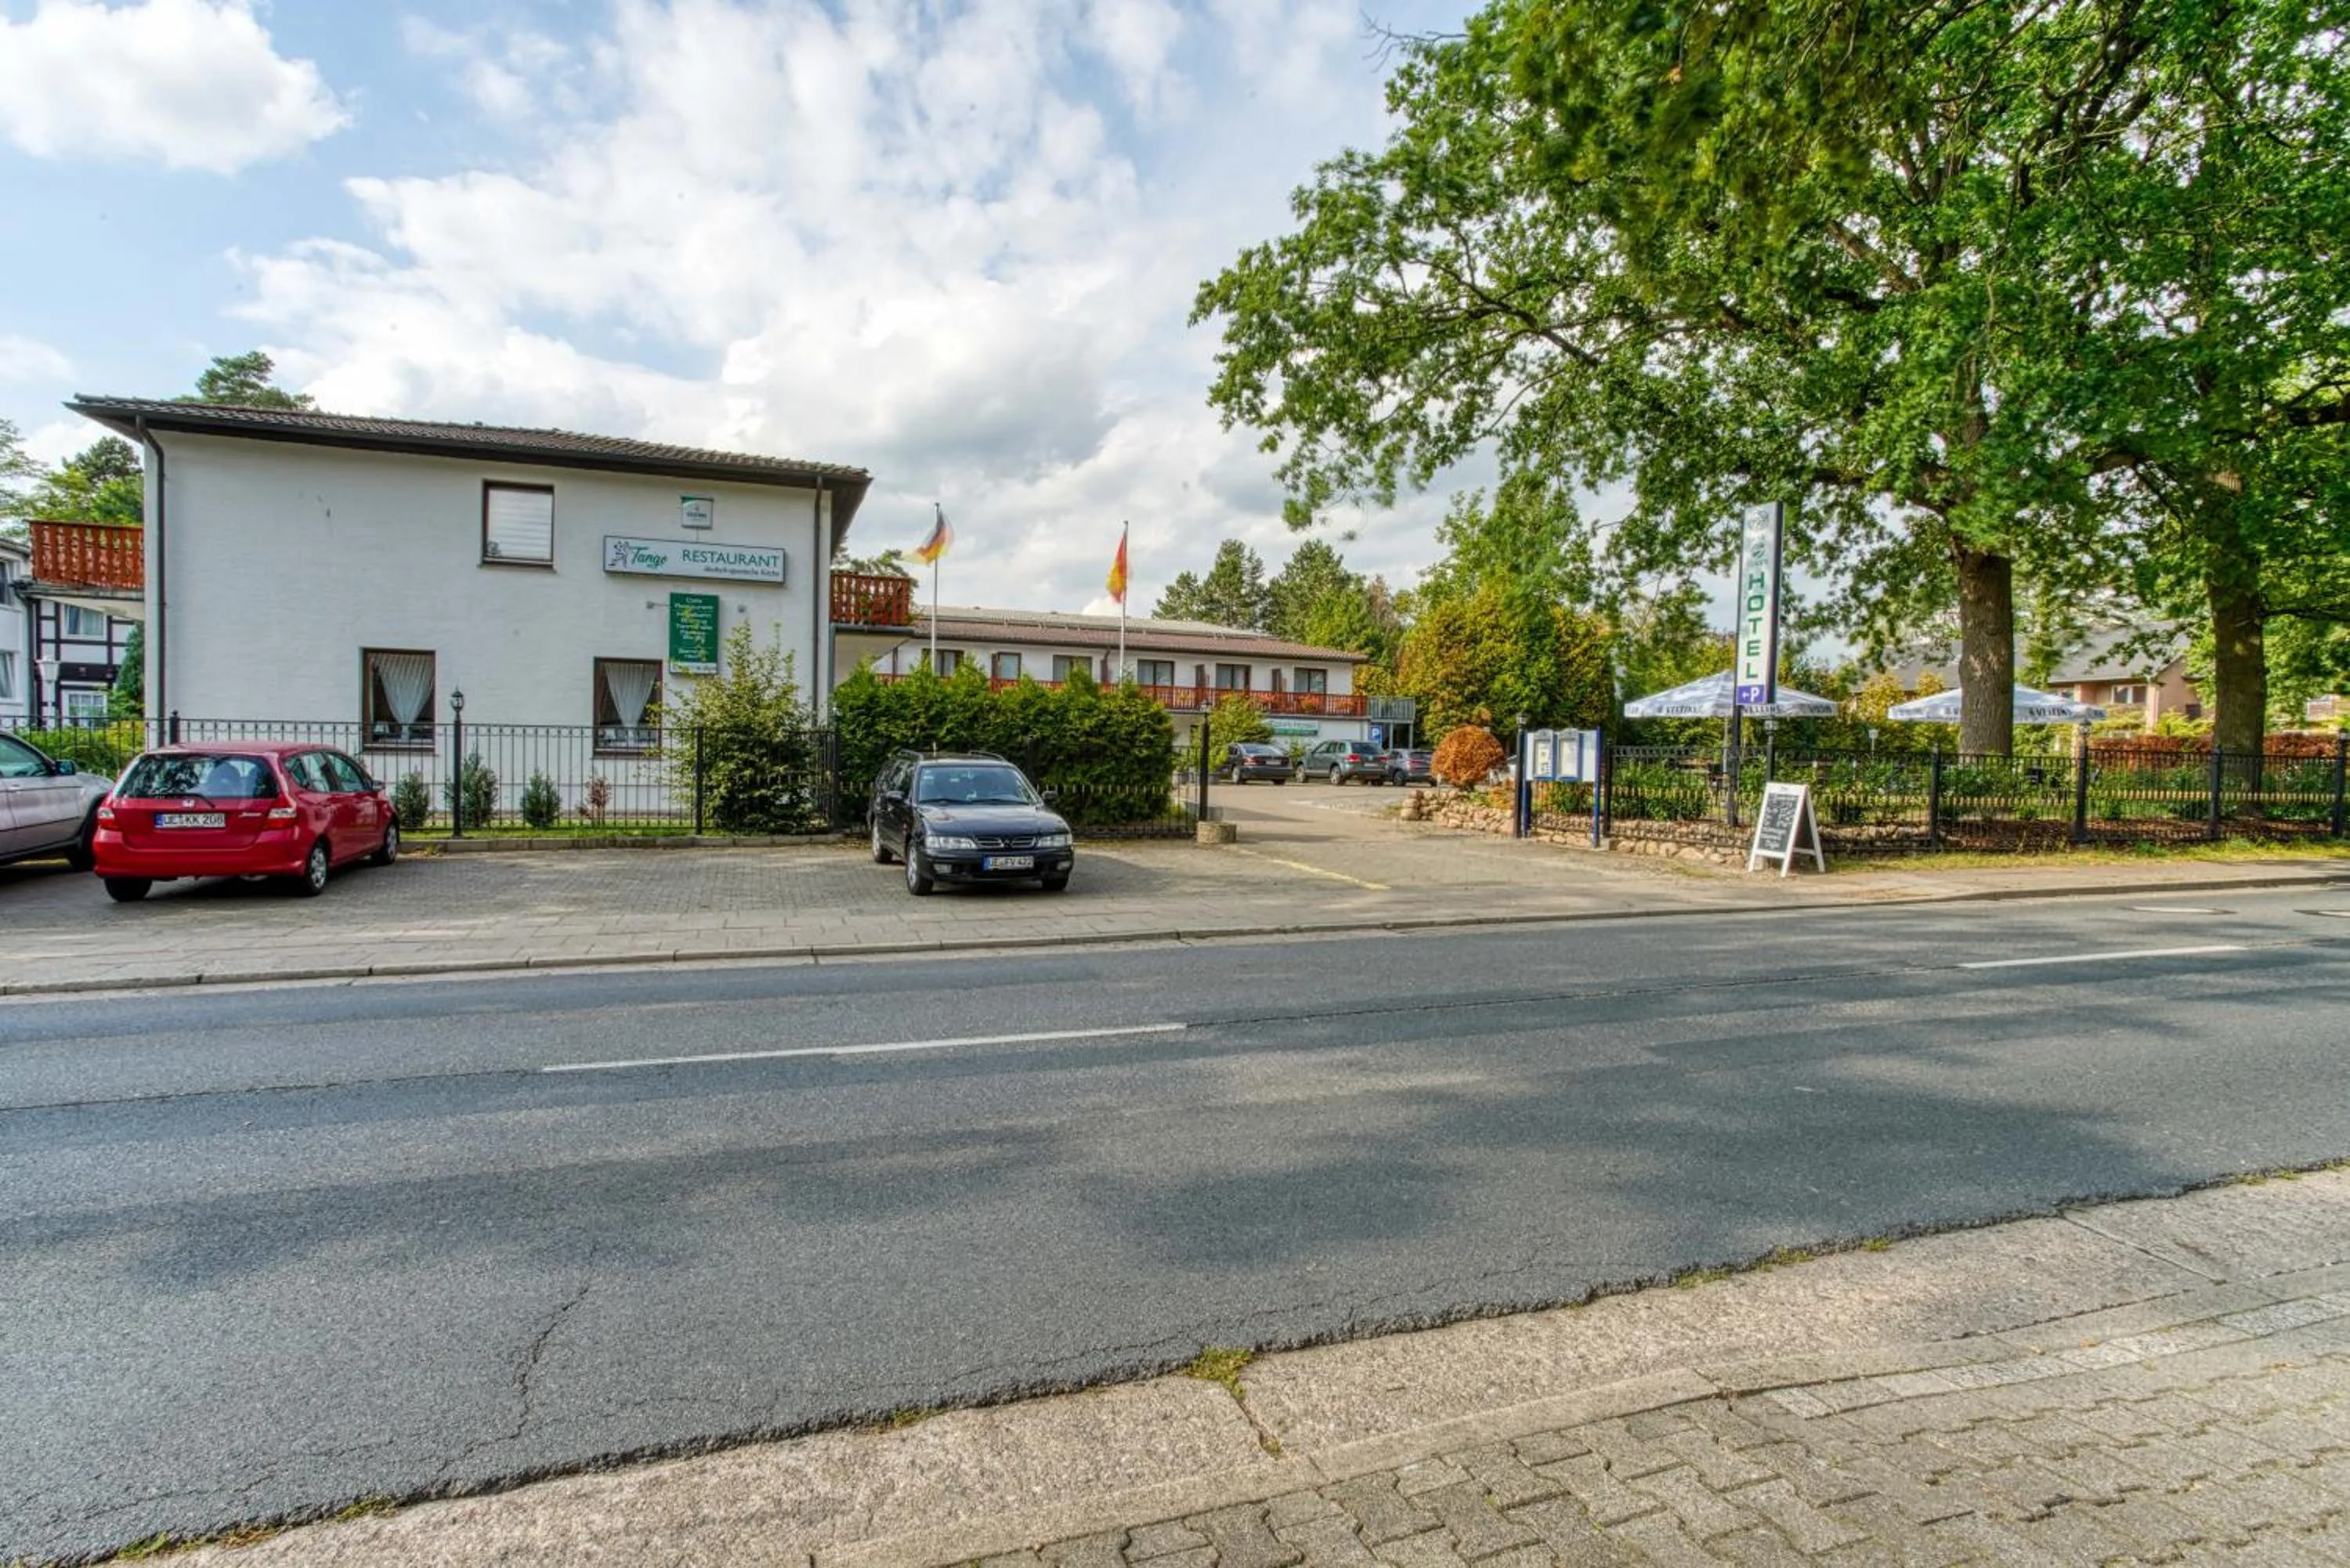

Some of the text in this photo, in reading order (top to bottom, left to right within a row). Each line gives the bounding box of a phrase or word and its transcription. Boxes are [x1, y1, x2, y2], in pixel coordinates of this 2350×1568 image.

[628, 546, 779, 569] Tango RESTAURANT
[1746, 571, 1765, 679] HOTEL
[1751, 687, 1760, 702] P
[1372, 728, 1379, 739] P
